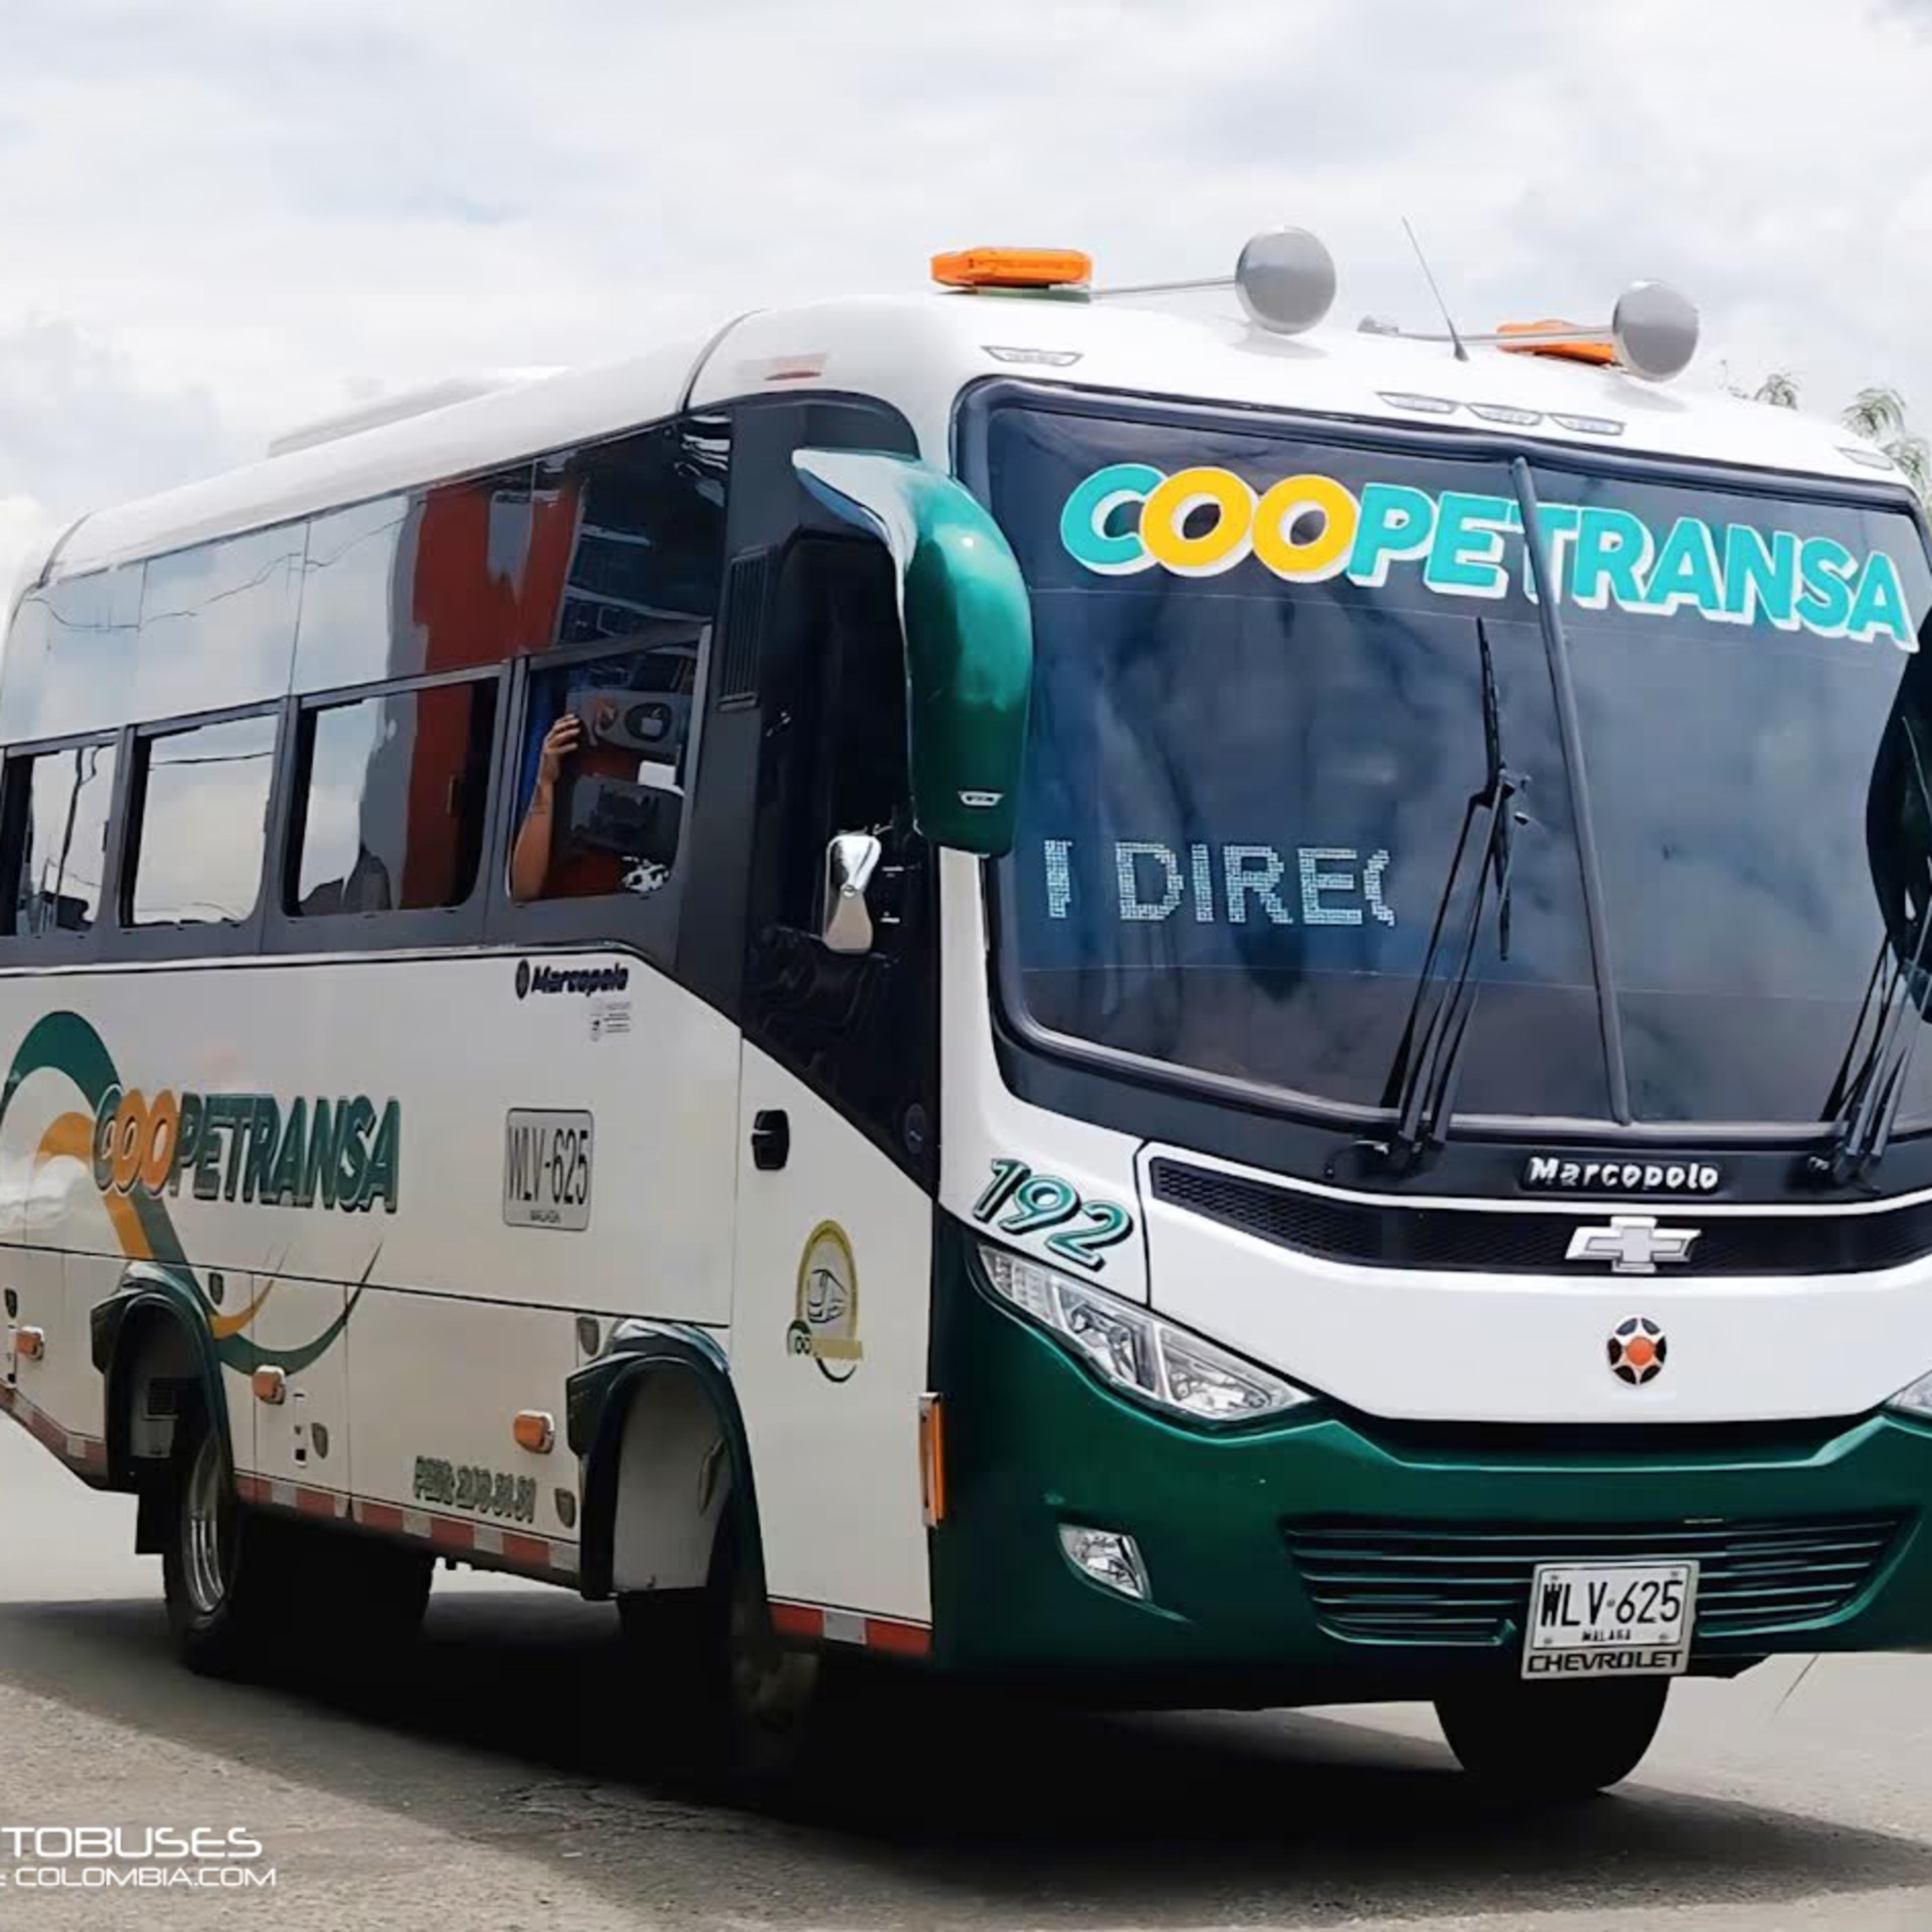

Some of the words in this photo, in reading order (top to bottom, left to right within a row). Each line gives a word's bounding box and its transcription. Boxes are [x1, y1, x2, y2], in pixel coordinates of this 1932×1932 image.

[1060, 462, 1919, 653] COOPETRANSA
[93, 1084, 401, 1215] COOPETRANSA
[1528, 1156, 1719, 1191] Marcopolo
[973, 1158, 1135, 1272] 192
[1527, 1650, 1683, 1673] CHEVROLET
